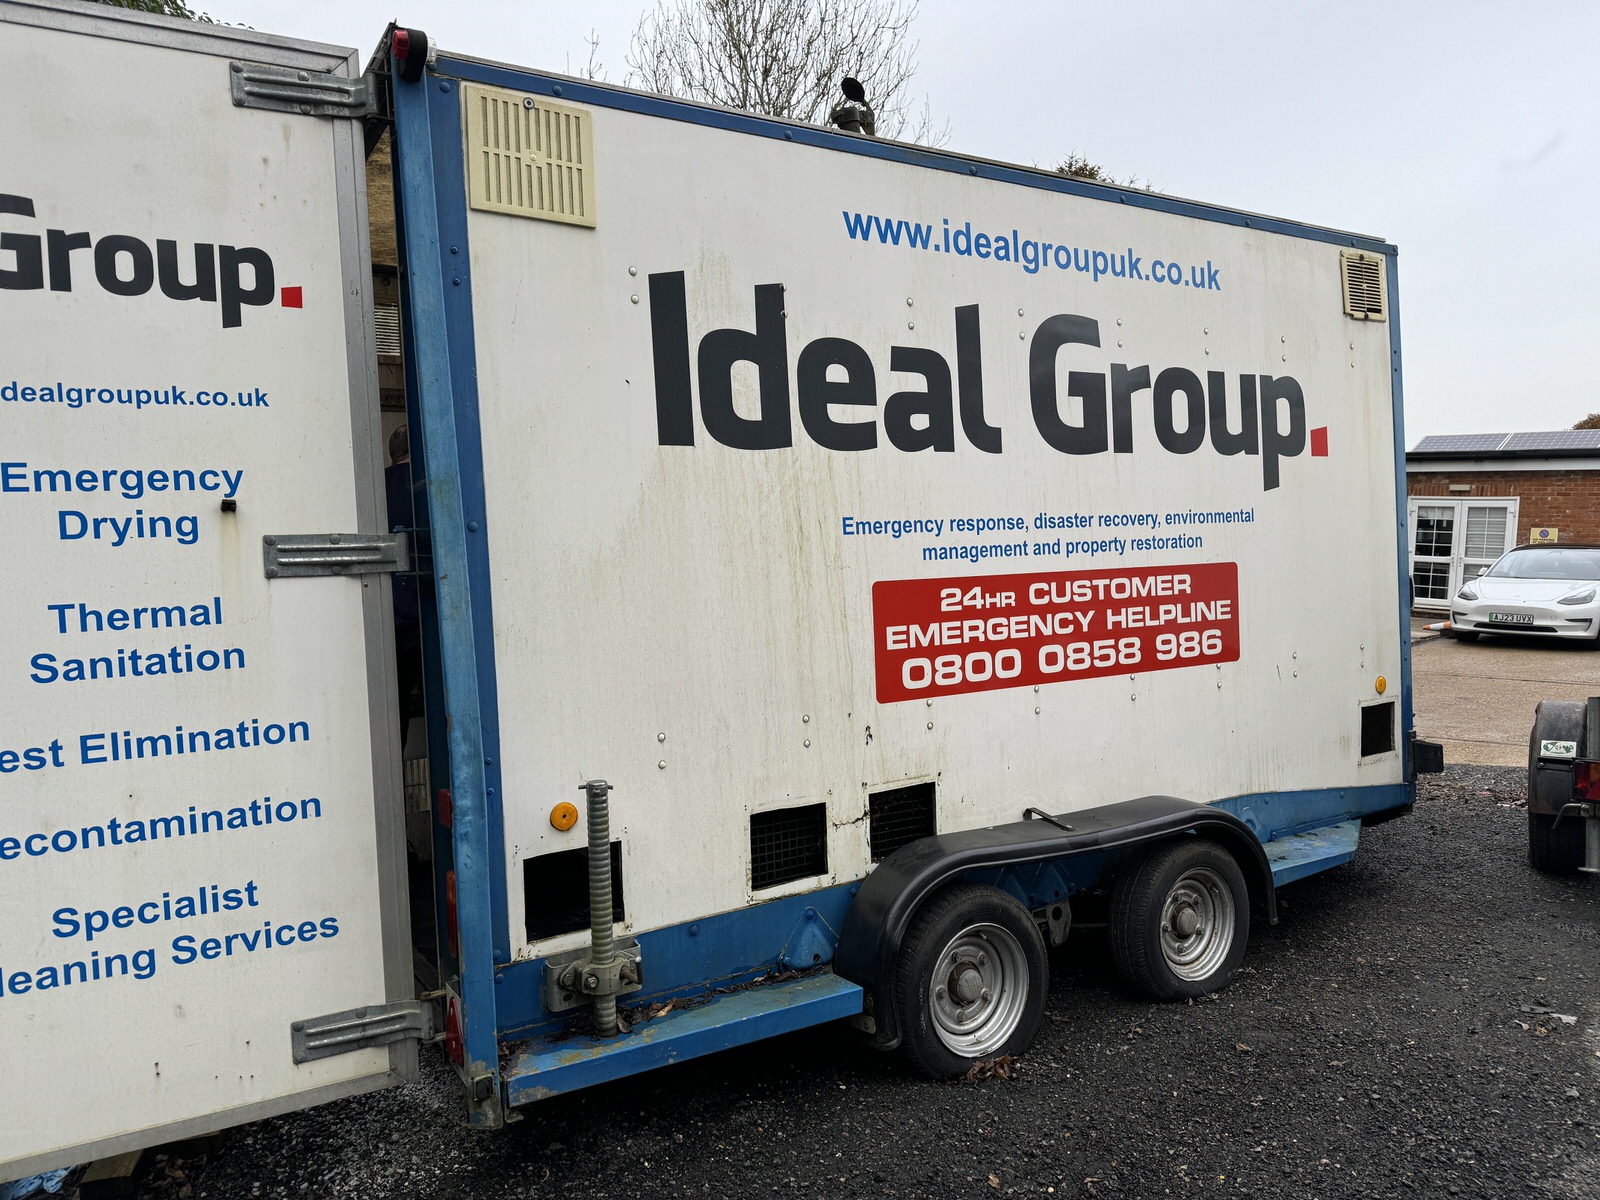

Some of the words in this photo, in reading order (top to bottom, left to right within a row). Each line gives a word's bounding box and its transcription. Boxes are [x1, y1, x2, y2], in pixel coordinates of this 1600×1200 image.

[843, 211, 1221, 291] www.idealgroupuk.co.uk
[648, 270, 1002, 454] Ideal
[1029, 313, 1329, 492] Group.
[0, 461, 243, 499] Emergency
[58, 509, 199, 547] Drying
[842, 514, 944, 538] Emergency
[949, 515, 1029, 535] response,
[1033, 511, 1094, 530] disaster
[1098, 511, 1162, 530] recovery,
[1164, 508, 1255, 526] environmental
[922, 540, 1029, 563] management
[1032, 538, 1061, 557] and
[1065, 537, 1127, 558] property
[1130, 533, 1204, 552] restoration
[940, 586, 1016, 612] 24HR
[1029, 573, 1192, 606] CUSTOMER
[47, 596, 223, 634] Thermal
[886, 610, 1096, 651] EMERGENCY
[1106, 600, 1232, 630] HELPLINE
[1494, 614, 1514, 622] AJ23
[1516, 615, 1532, 623] UVX
[30, 644, 246, 684] Sanitation
[901, 648, 1022, 690] 0800
[1038, 637, 1142, 675] 0858
[1156, 628, 1223, 662] 986
[80, 719, 310, 764] Elimination
[52, 880, 259, 941] Specialist
[172, 915, 340, 965] Services
